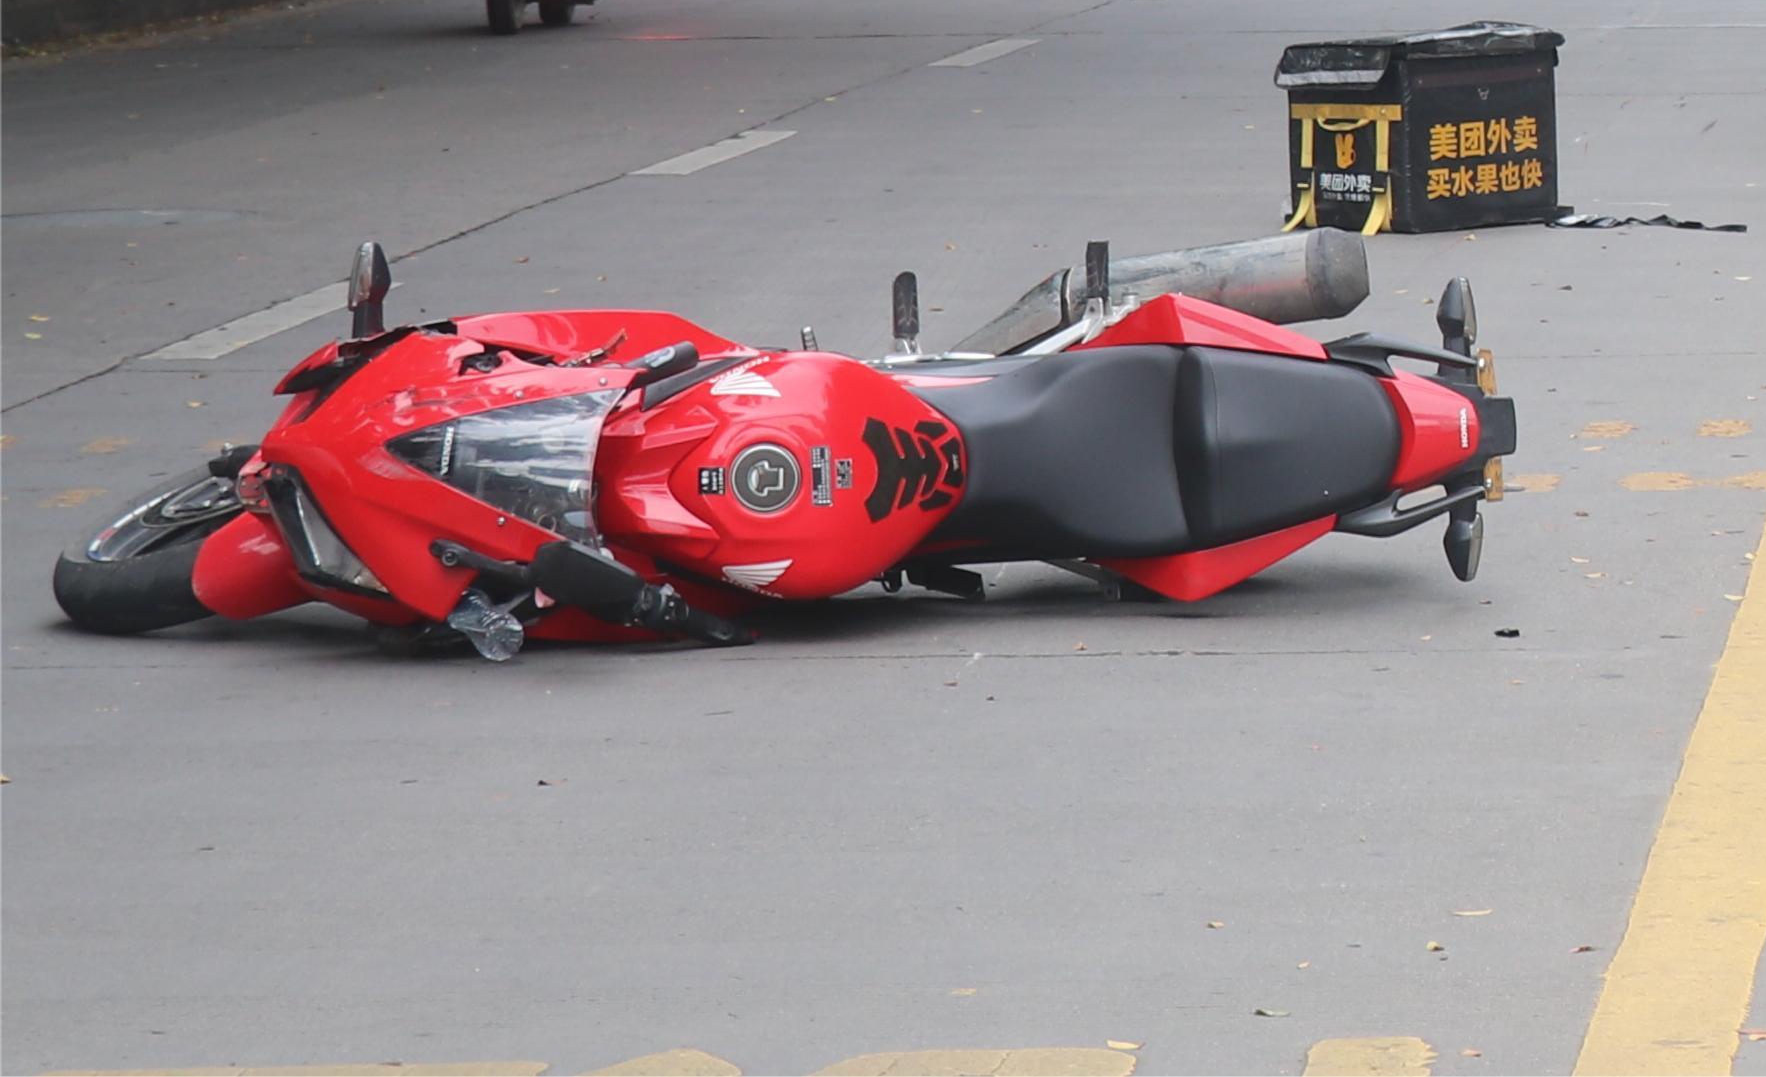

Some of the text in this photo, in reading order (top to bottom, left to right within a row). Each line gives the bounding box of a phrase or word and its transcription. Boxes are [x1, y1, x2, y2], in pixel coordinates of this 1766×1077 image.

[1428, 115, 1539, 161] 美团外卖
[1320, 173, 1372, 193] 美团外卖
[1426, 158, 1543, 200] 买水果也快
[1459, 407, 1469, 449] HONDA
[440, 426, 454, 476] HONDA
